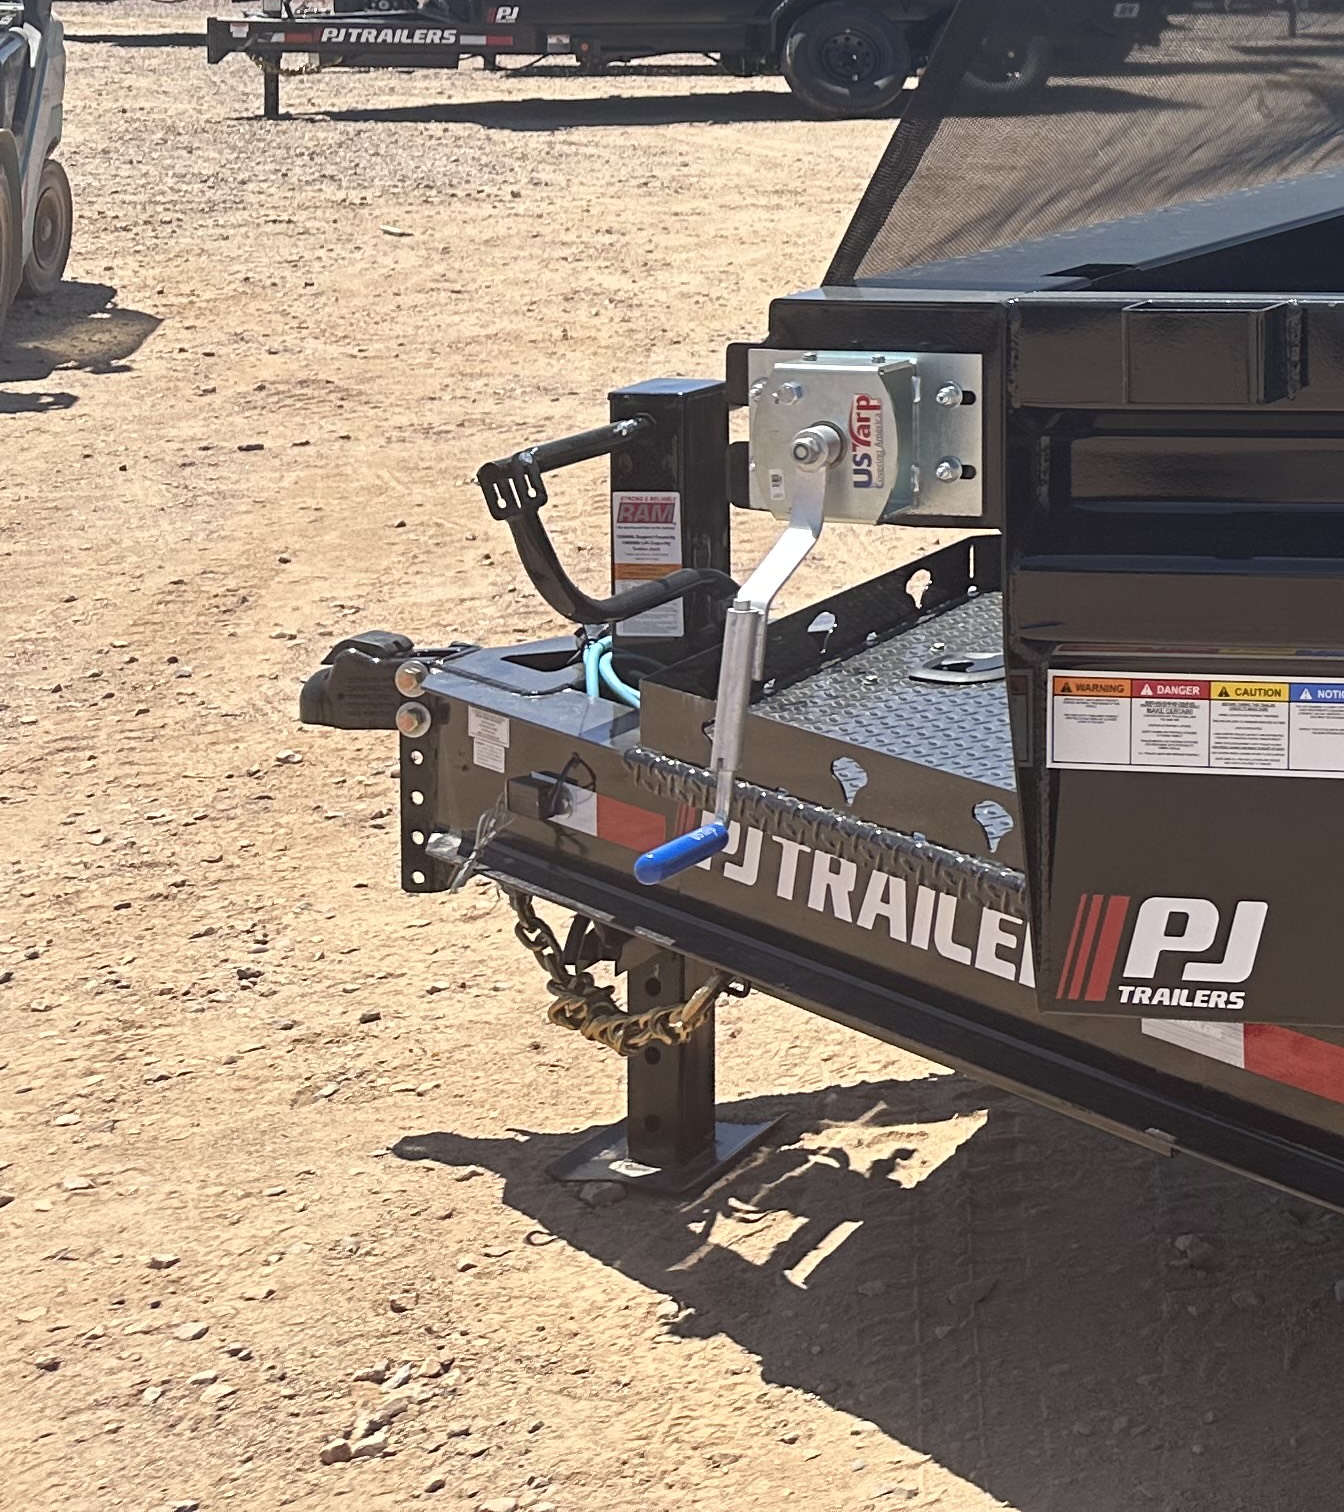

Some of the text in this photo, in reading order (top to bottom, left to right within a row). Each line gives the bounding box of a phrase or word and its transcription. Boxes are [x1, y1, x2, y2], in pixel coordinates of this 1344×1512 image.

[618, 503, 675, 523] RAM
[1075, 683, 1125, 694] WARNING
[1156, 684, 1201, 696] DANGER
[1234, 687, 1282, 698] CAUTION
[1120, 895, 1269, 984] PJ
[1118, 984, 1247, 1010] TRAILERS
